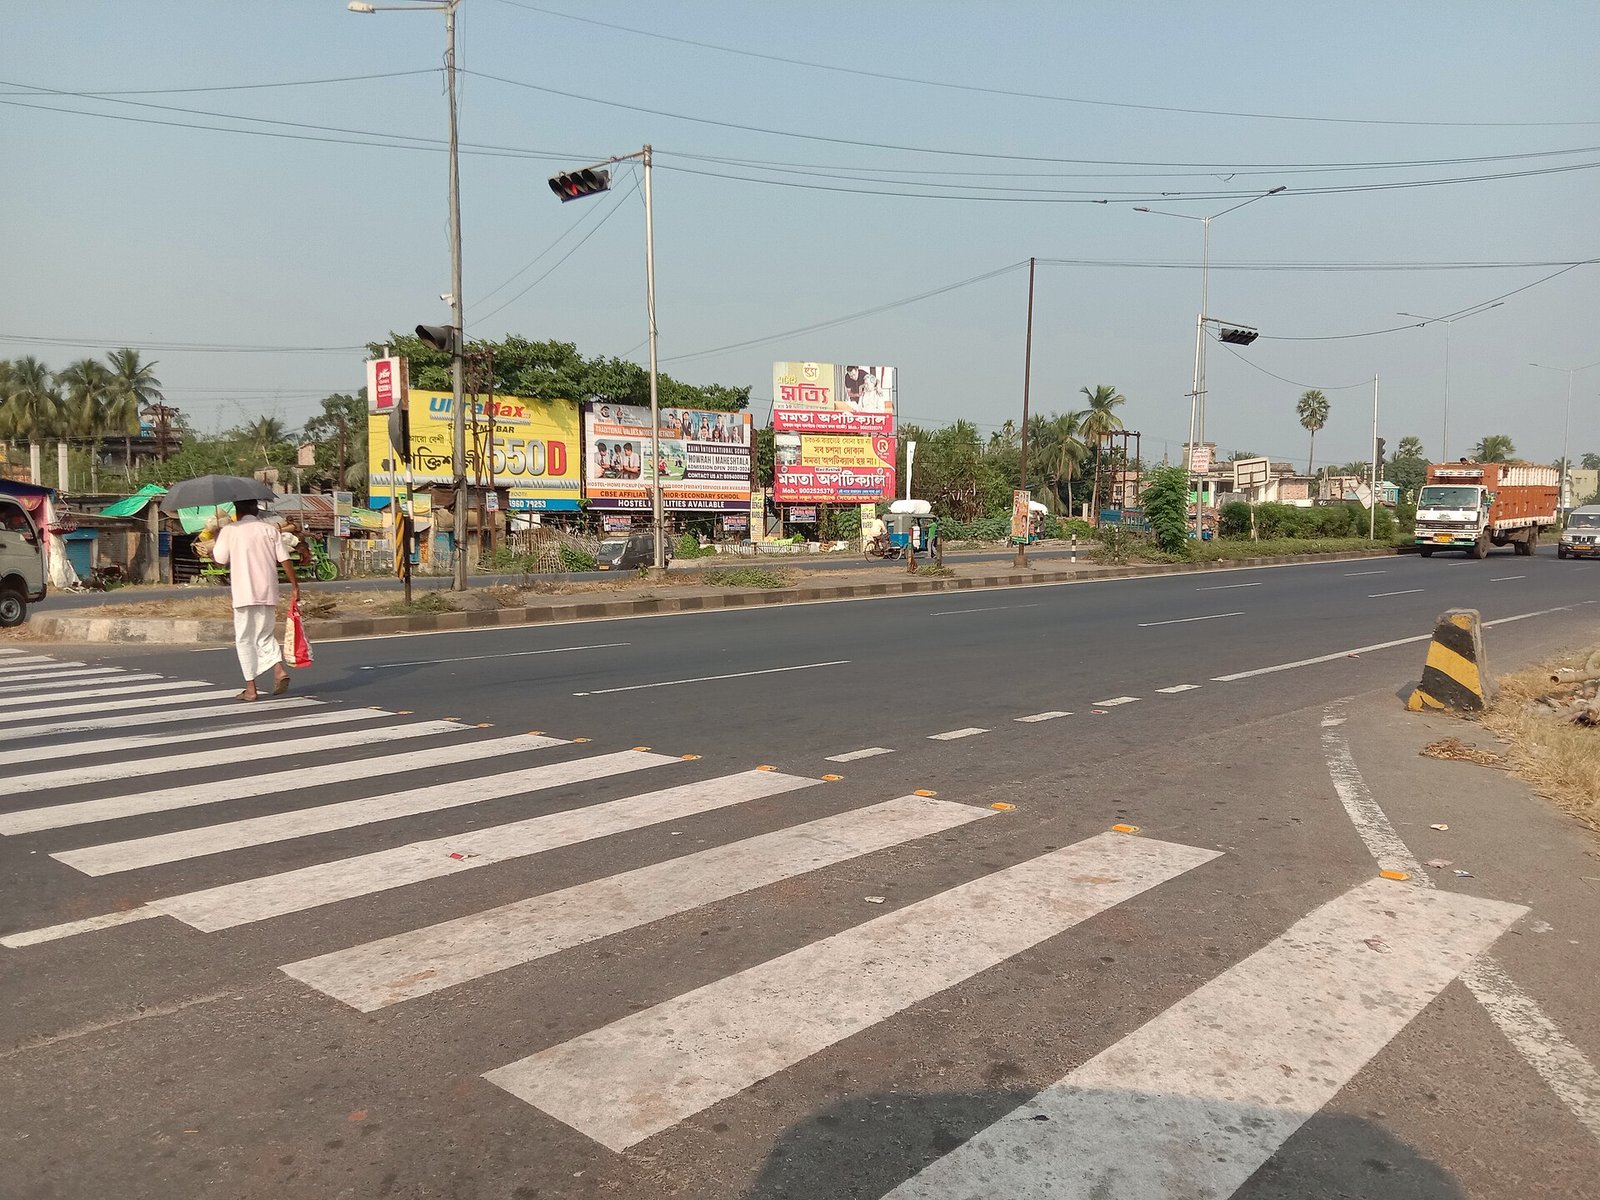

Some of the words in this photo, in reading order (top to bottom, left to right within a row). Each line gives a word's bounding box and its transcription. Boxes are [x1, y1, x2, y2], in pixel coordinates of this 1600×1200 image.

[778, 412, 814, 423] মমতা
[496, 425, 515, 433] BAR
[485, 438, 567, 476] 550D
[688, 455, 711, 464] HOWRAH
[777, 473, 814, 486] মমতা
[816, 470, 886, 487] অপটিক্যাল
[688, 500, 725, 508] AVAILABLE
